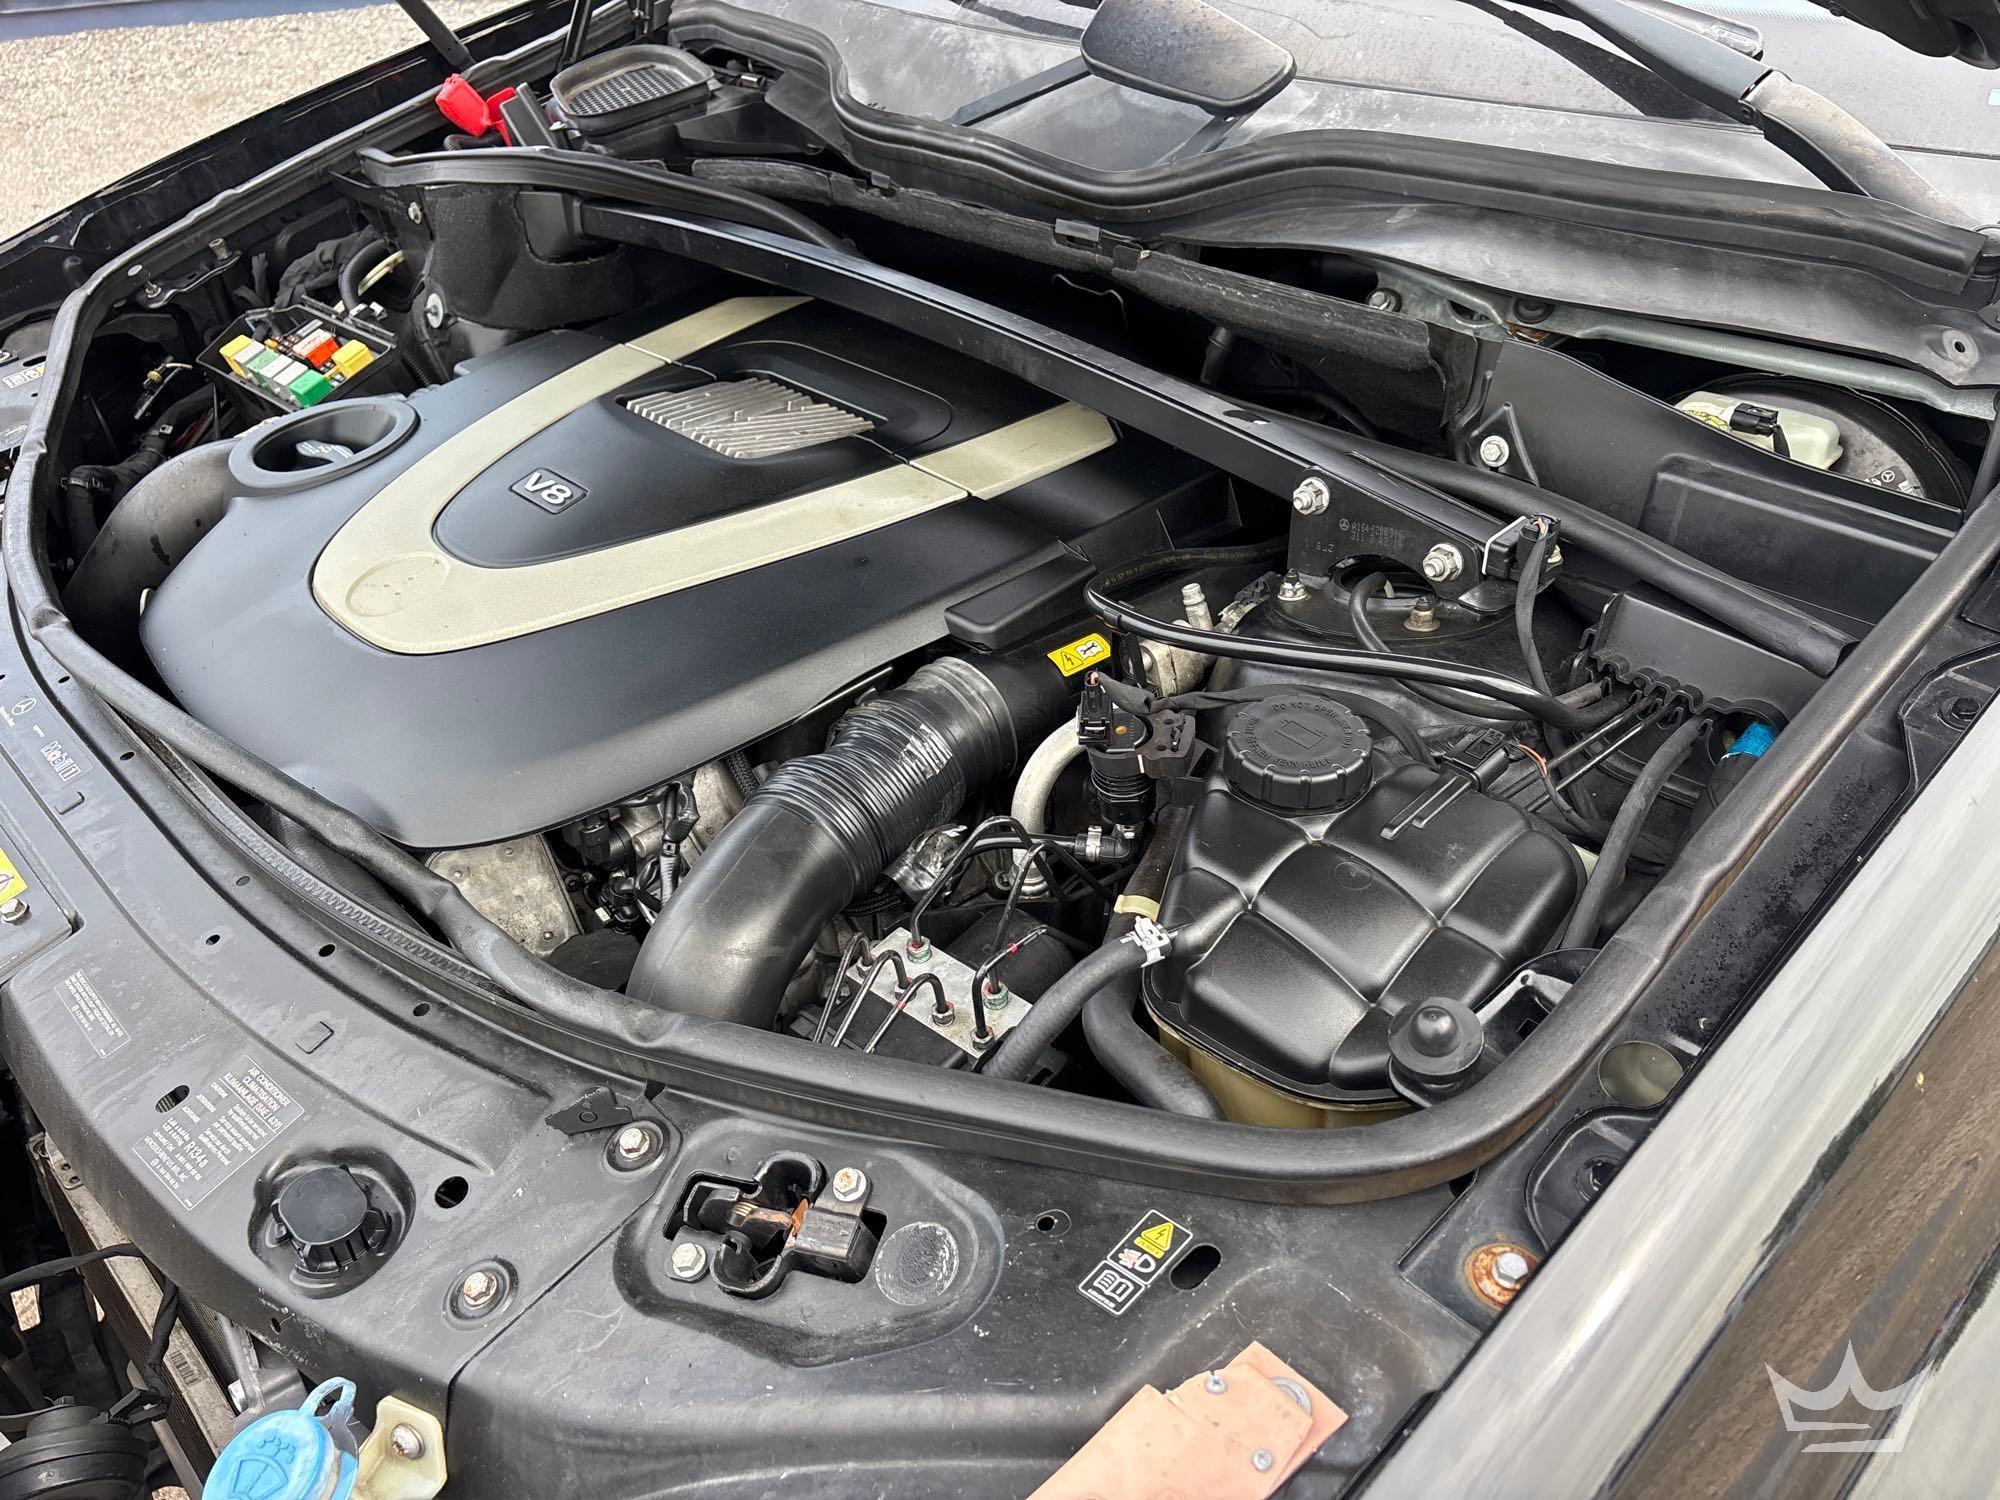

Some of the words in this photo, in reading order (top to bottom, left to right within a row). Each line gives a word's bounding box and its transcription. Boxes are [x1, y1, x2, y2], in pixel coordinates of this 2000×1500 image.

[524, 472, 572, 504] V8
[1272, 703, 1286, 712] DO
[1313, 704, 1338, 719] OPEN
[40, 740, 74, 772] Mobil
[223, 1073, 258, 1108] KLIMAANLAGE
[253, 1102, 268, 1117] (SAE
[266, 1115, 282, 1131] 639)
[242, 1077, 280, 1111] CLIMATISATION
[248, 1067, 260, 1077] AIR
[256, 1075, 290, 1107] CONDITIONER
[183, 1140, 210, 1167] R134a
